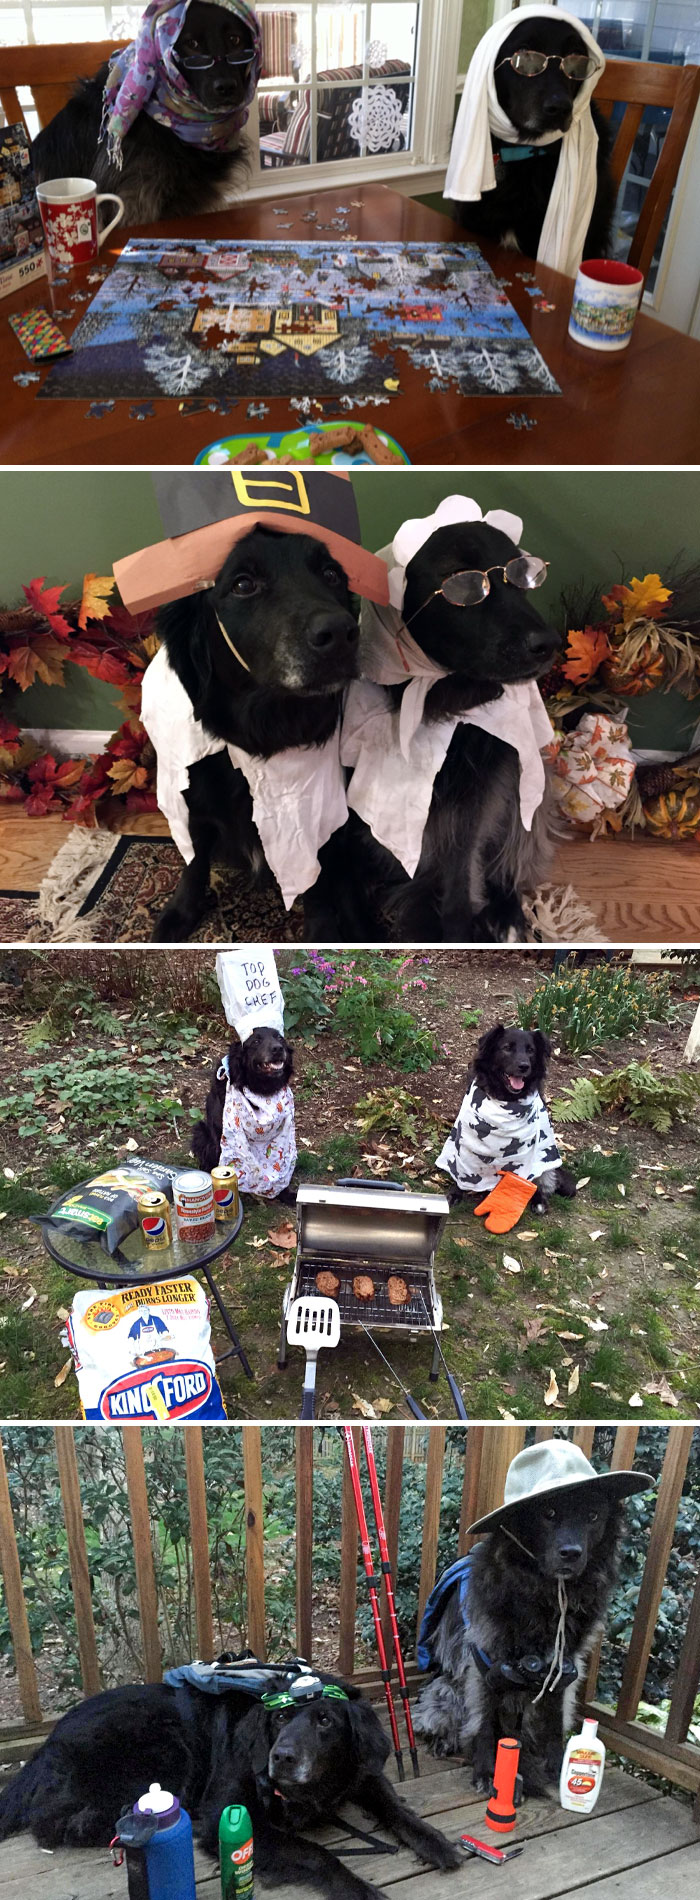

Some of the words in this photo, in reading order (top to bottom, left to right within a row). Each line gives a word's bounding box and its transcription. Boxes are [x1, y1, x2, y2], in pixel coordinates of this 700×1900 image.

[19, 262, 35, 277] 550
[241, 961, 265, 976] TOP
[245, 978, 270, 991] DOG
[244, 991, 277, 1007] CHEF
[121, 1286, 153, 1304] READY
[155, 1282, 194, 1296] FASTER
[135, 1296, 161, 1308] BURNS
[162, 1293, 196, 1303] LONGER
[571, 1778, 582, 1786] 45
